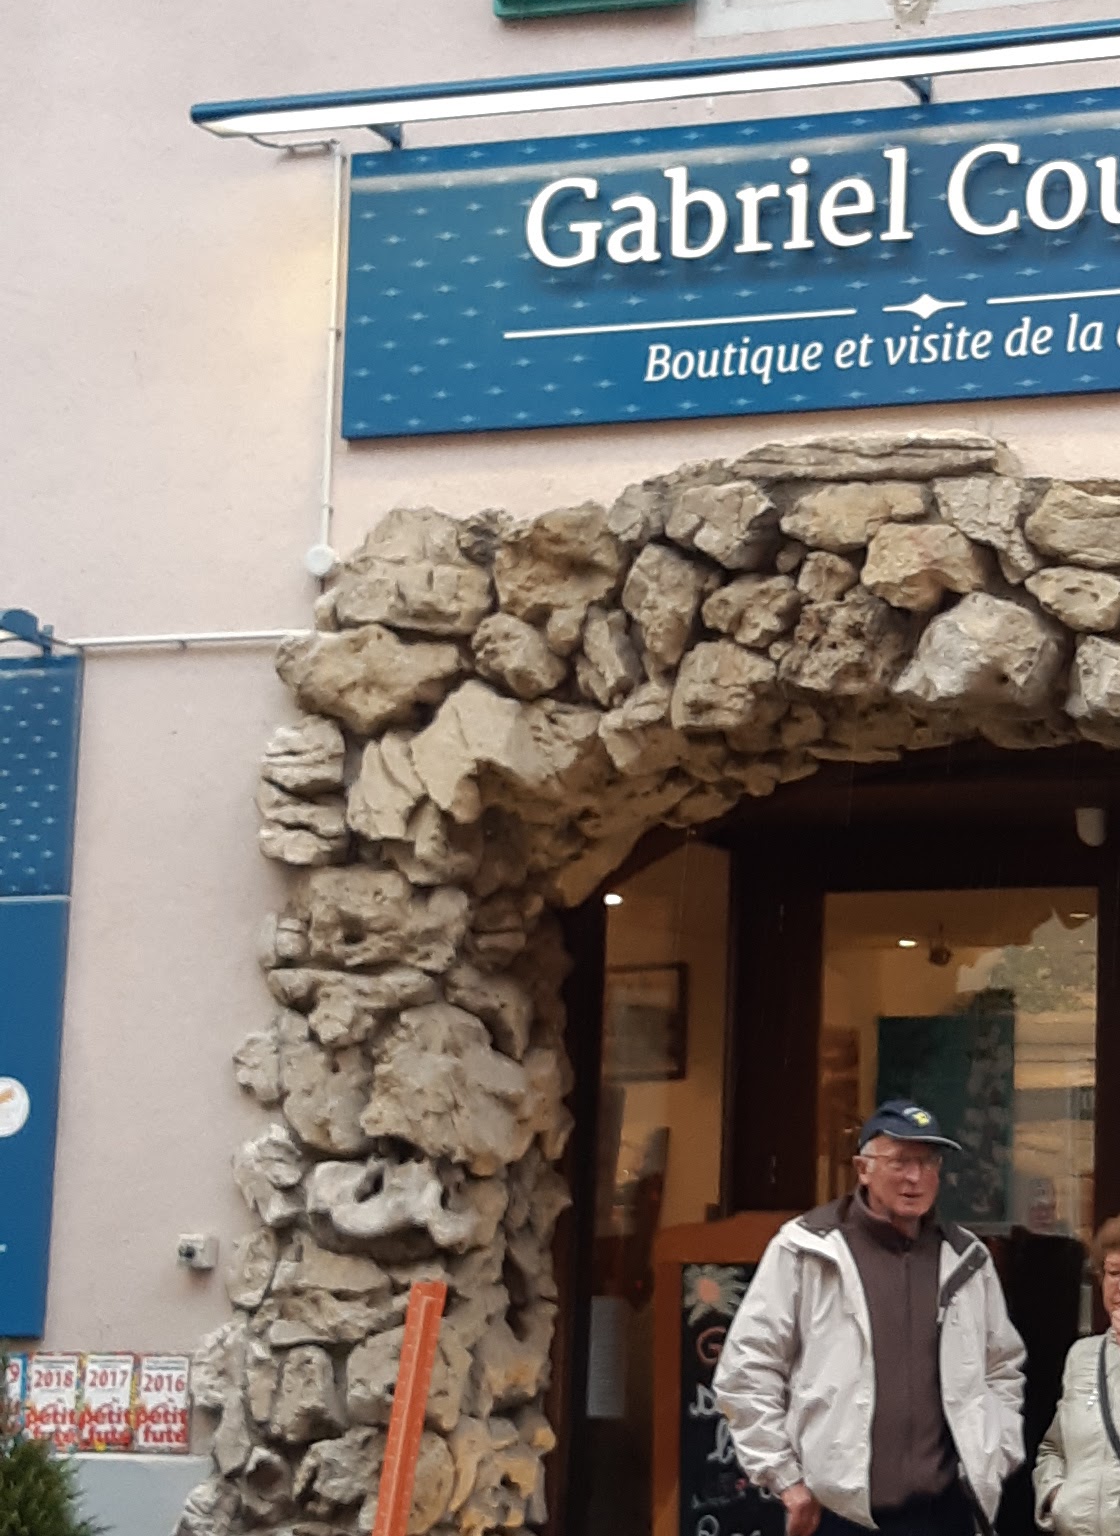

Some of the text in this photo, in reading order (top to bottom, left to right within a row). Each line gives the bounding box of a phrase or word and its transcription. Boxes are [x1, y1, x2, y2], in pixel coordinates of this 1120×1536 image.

[526, 146, 913, 268] Gabriel
[643, 335, 822, 385] Boutique
[833, 332, 873, 368] et
[885, 321, 992, 366] visite
[1004, 316, 1054, 359] de
[1065, 311, 1104, 353] la
[34, 1368, 75, 1388] 2018
[88, 1368, 129, 1388] 2017
[142, 1373, 186, 1393] 2016
